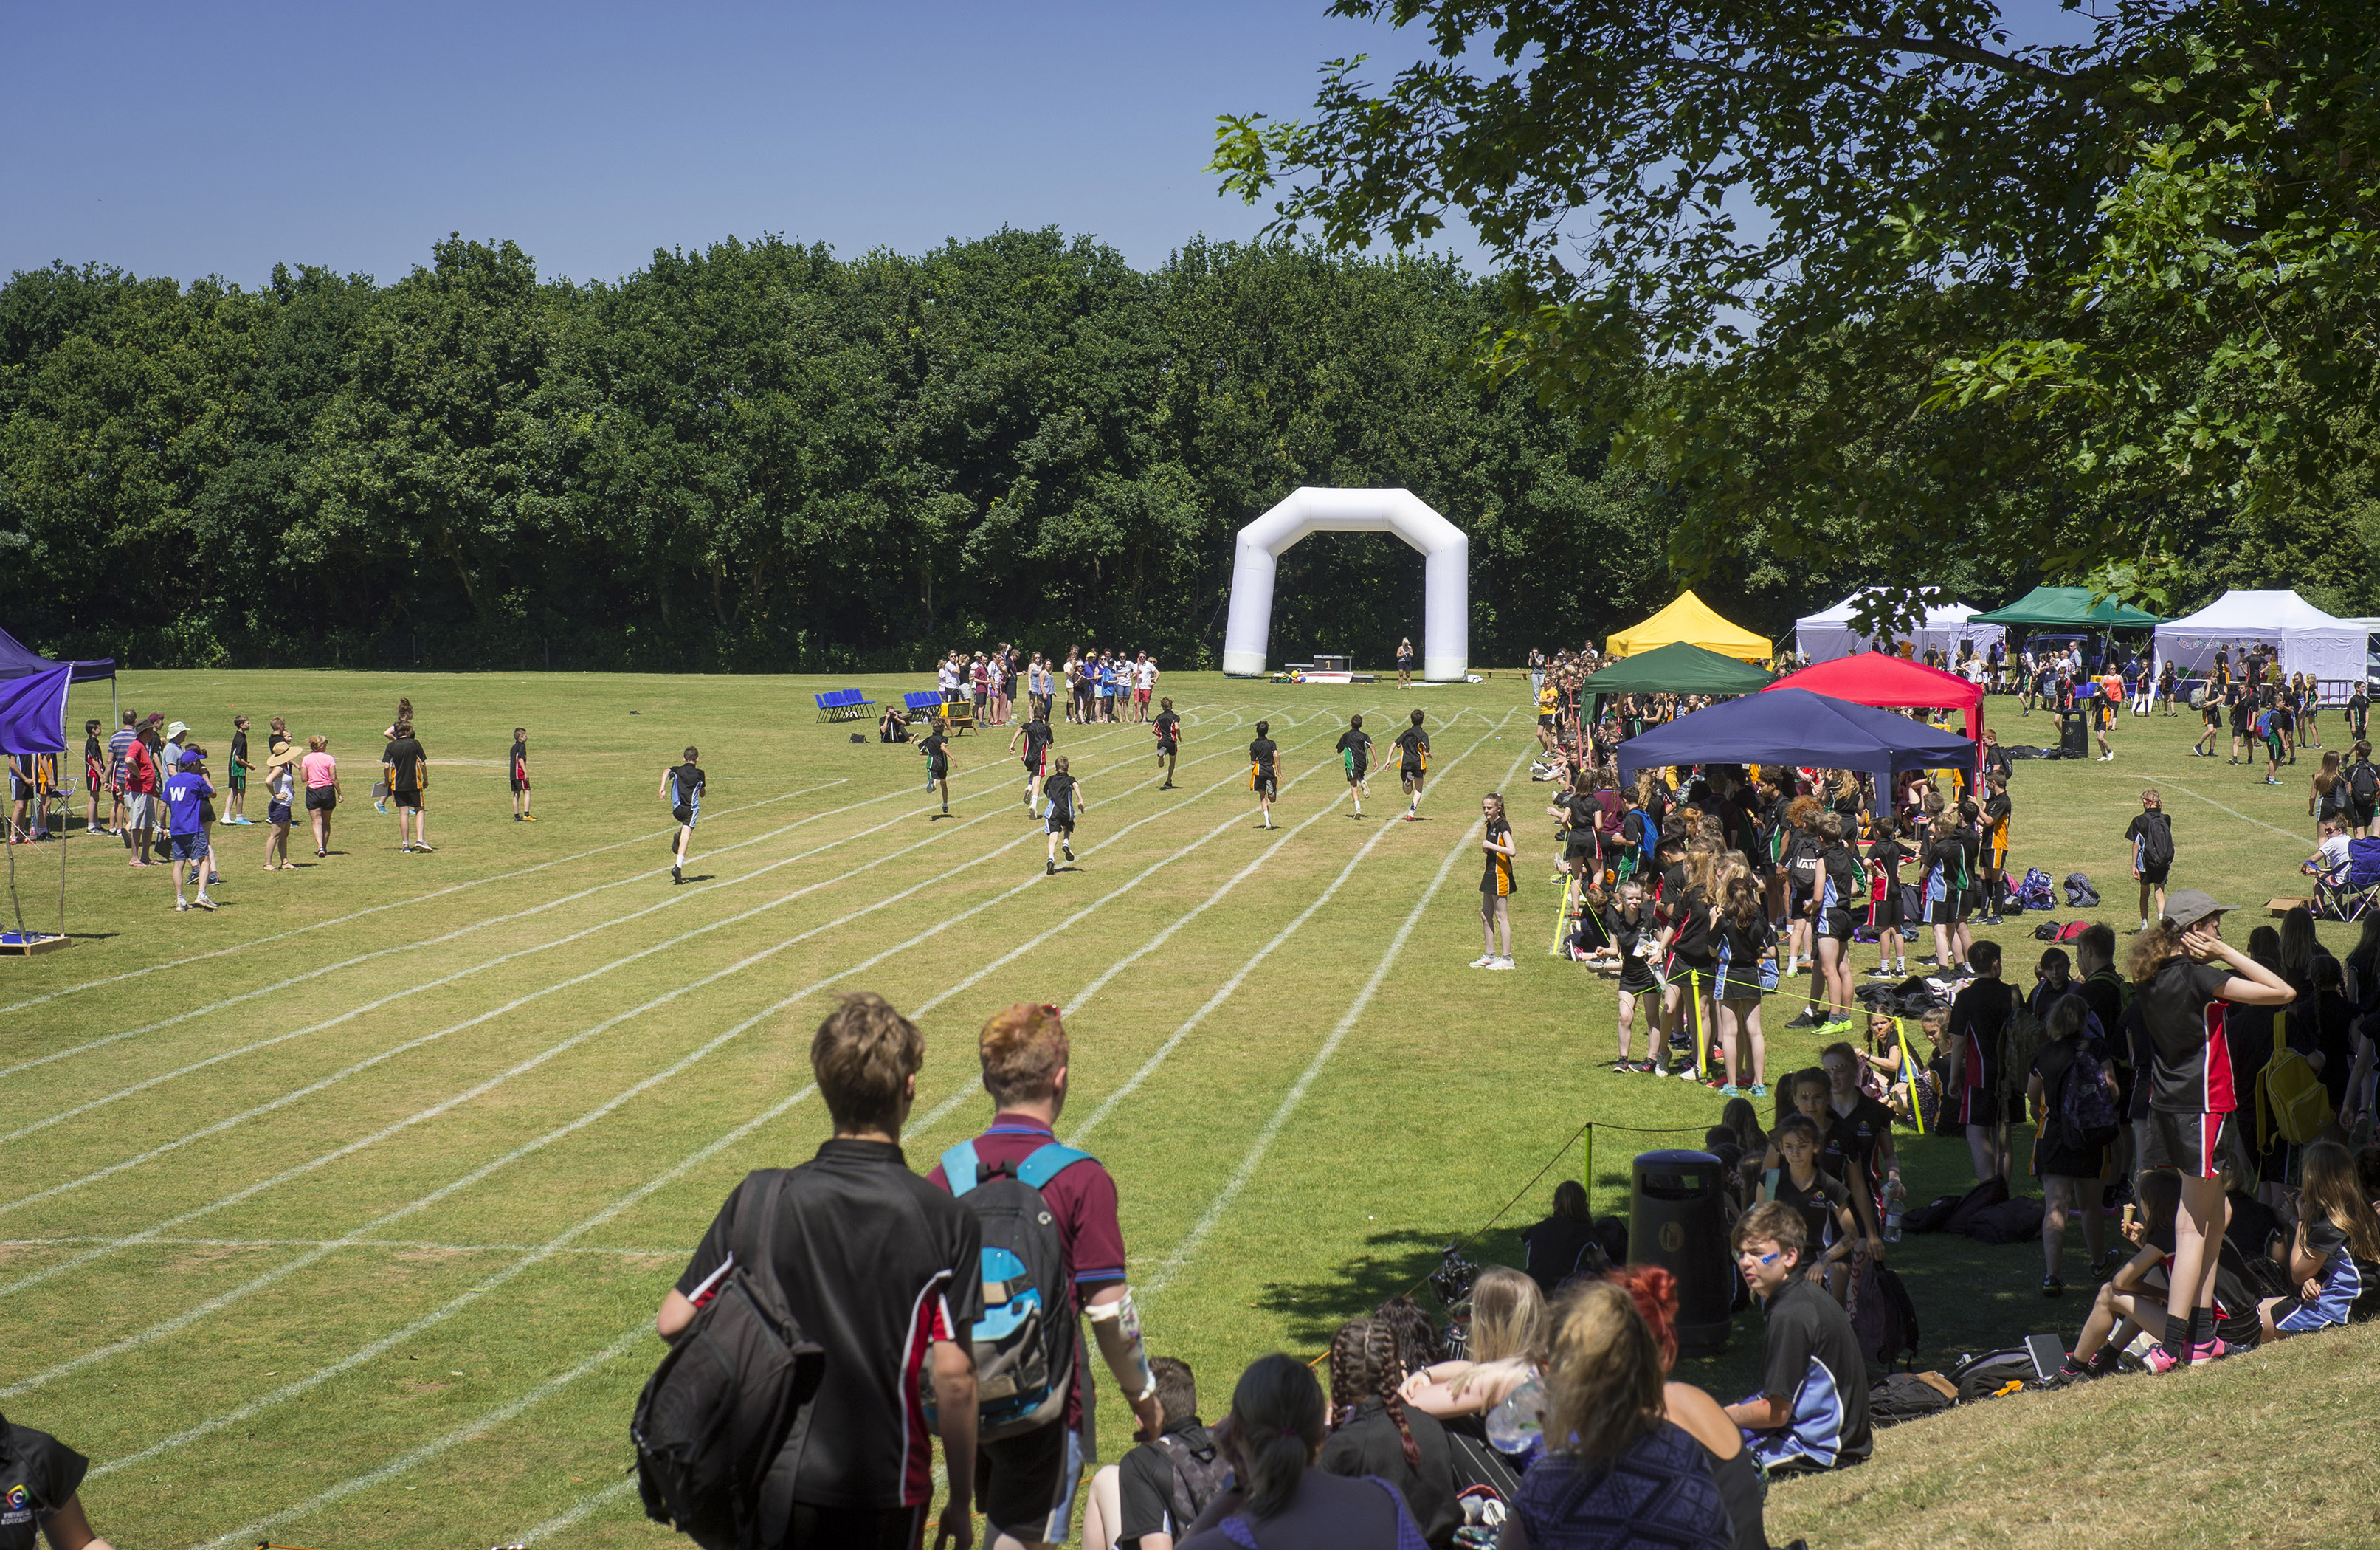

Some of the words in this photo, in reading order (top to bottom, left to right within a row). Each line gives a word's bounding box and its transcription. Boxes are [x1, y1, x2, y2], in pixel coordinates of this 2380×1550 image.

[1325, 660, 1331, 670] 1
[170, 787, 187, 802] W
[1796, 855, 1817, 869] VAN
[13, 1491, 24, 1504] C
